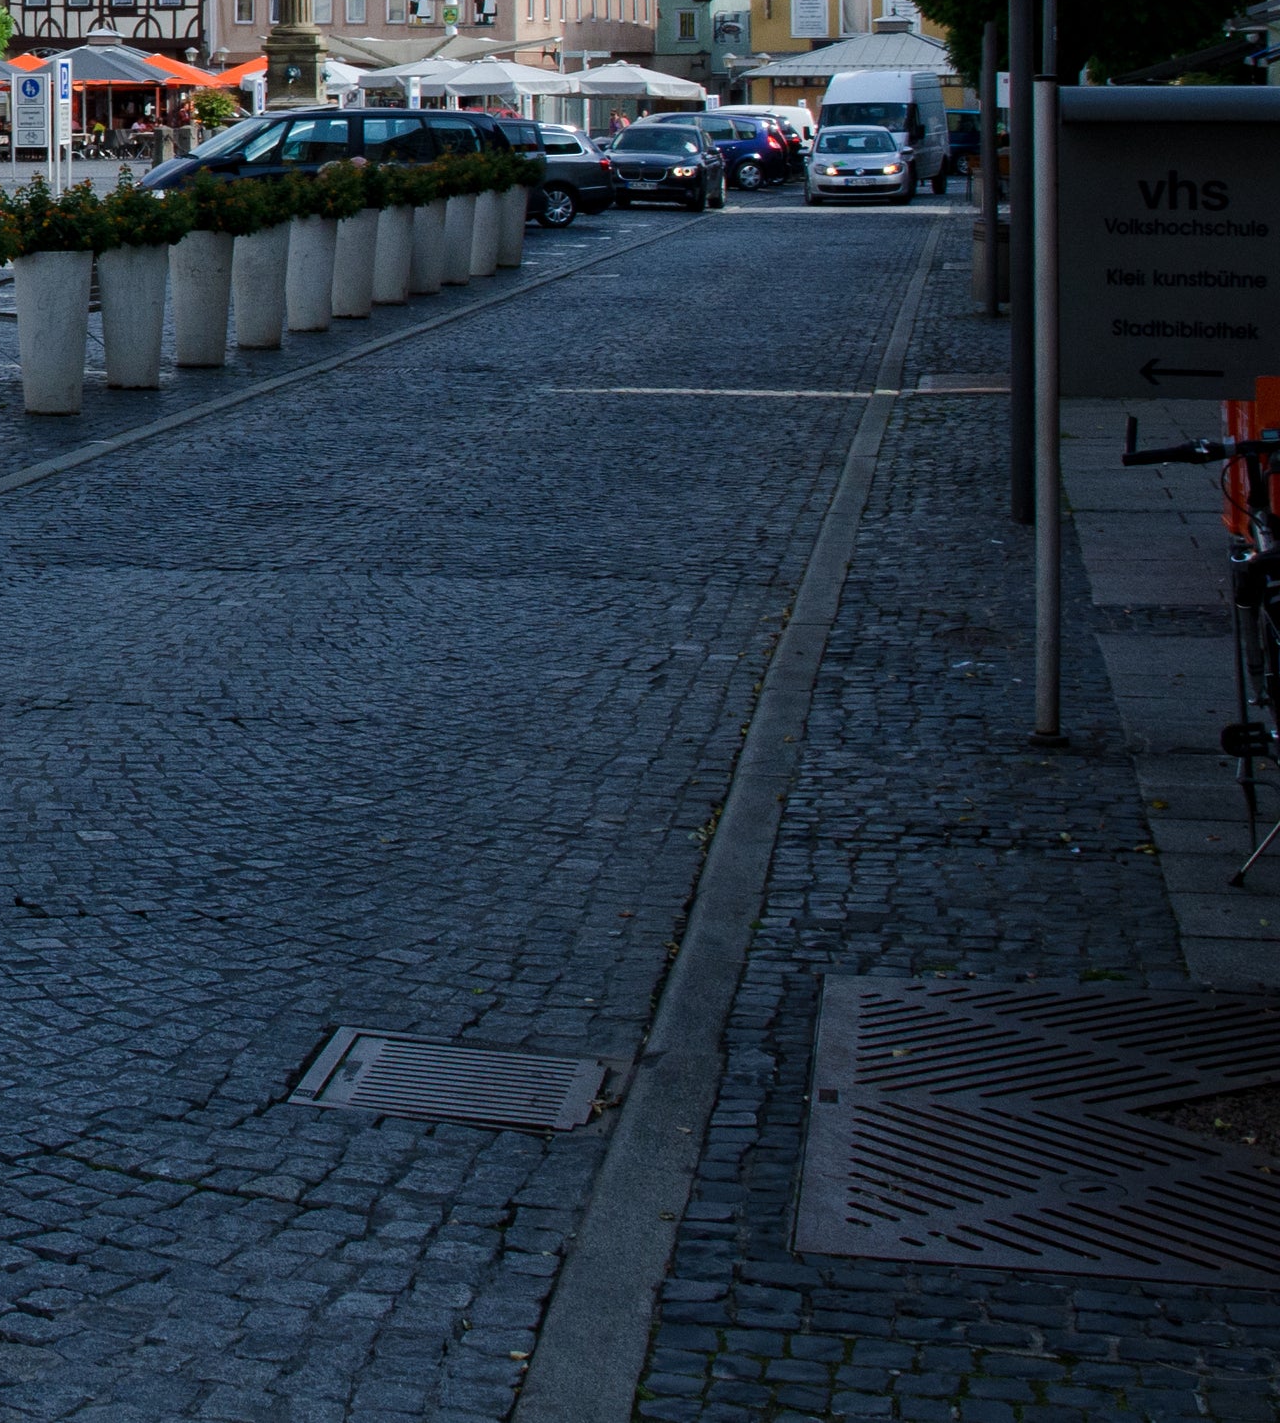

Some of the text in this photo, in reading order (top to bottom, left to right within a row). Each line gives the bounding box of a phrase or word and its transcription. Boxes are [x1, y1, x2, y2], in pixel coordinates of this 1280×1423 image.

[1138, 169, 1230, 211] vhs
[1104, 218, 1269, 238] Volkshochschule
[1111, 319, 1260, 340] Stadtbibliothek
